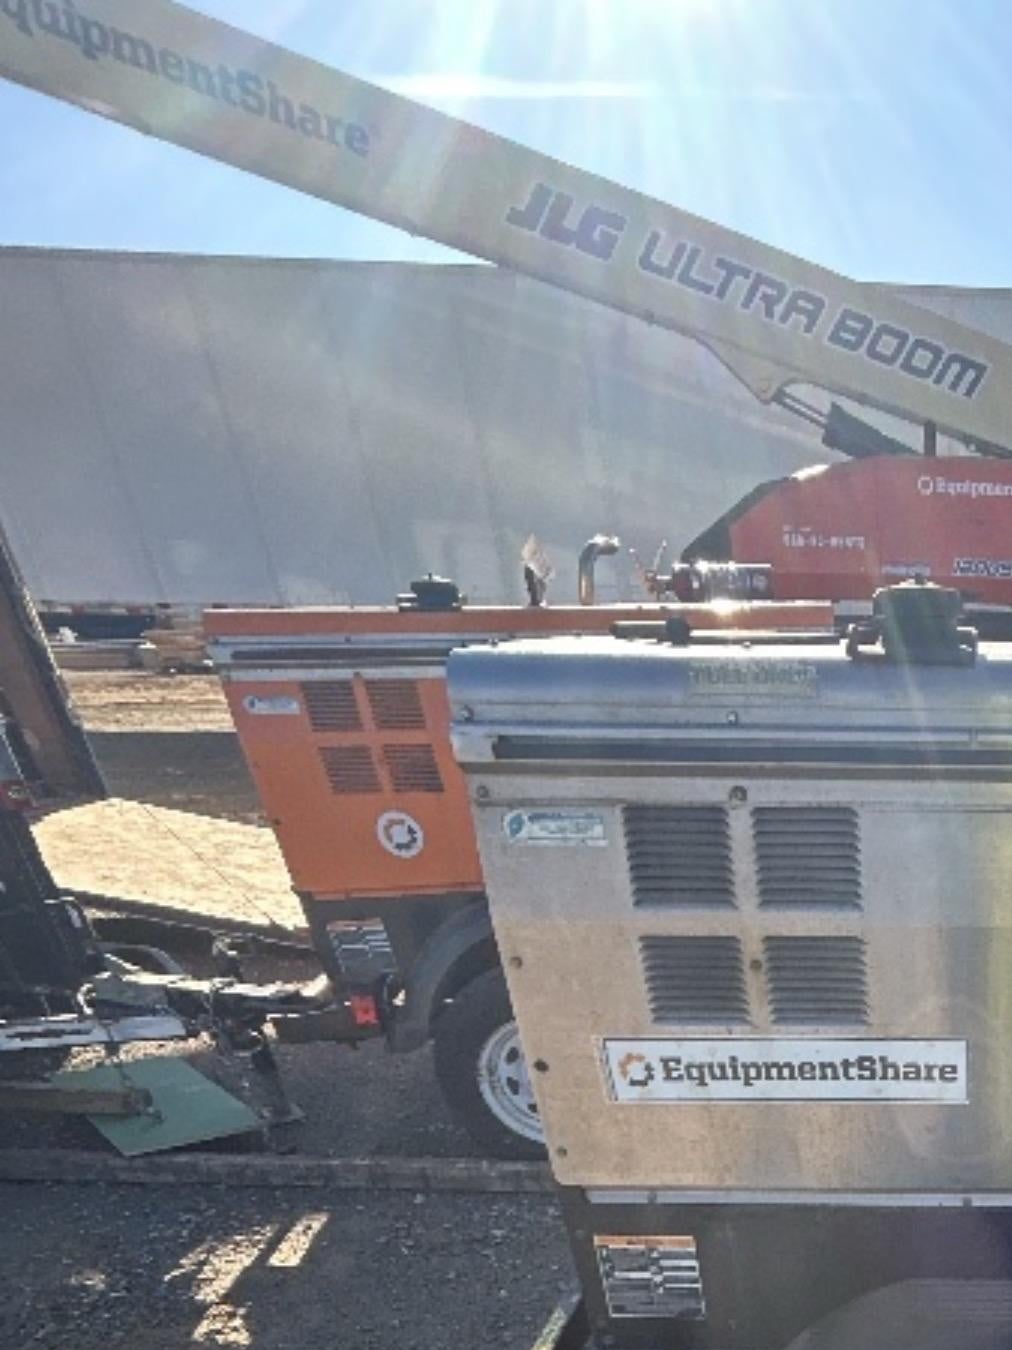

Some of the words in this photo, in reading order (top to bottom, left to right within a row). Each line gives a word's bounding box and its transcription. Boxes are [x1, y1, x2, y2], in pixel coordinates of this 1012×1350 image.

[0, 0, 371, 156] quipmentShare
[505, 181, 628, 261] JLG
[637, 228, 825, 333] ULTRA
[827, 305, 988, 400] BOOM
[660, 1055, 958, 1087] EquipmentShare
